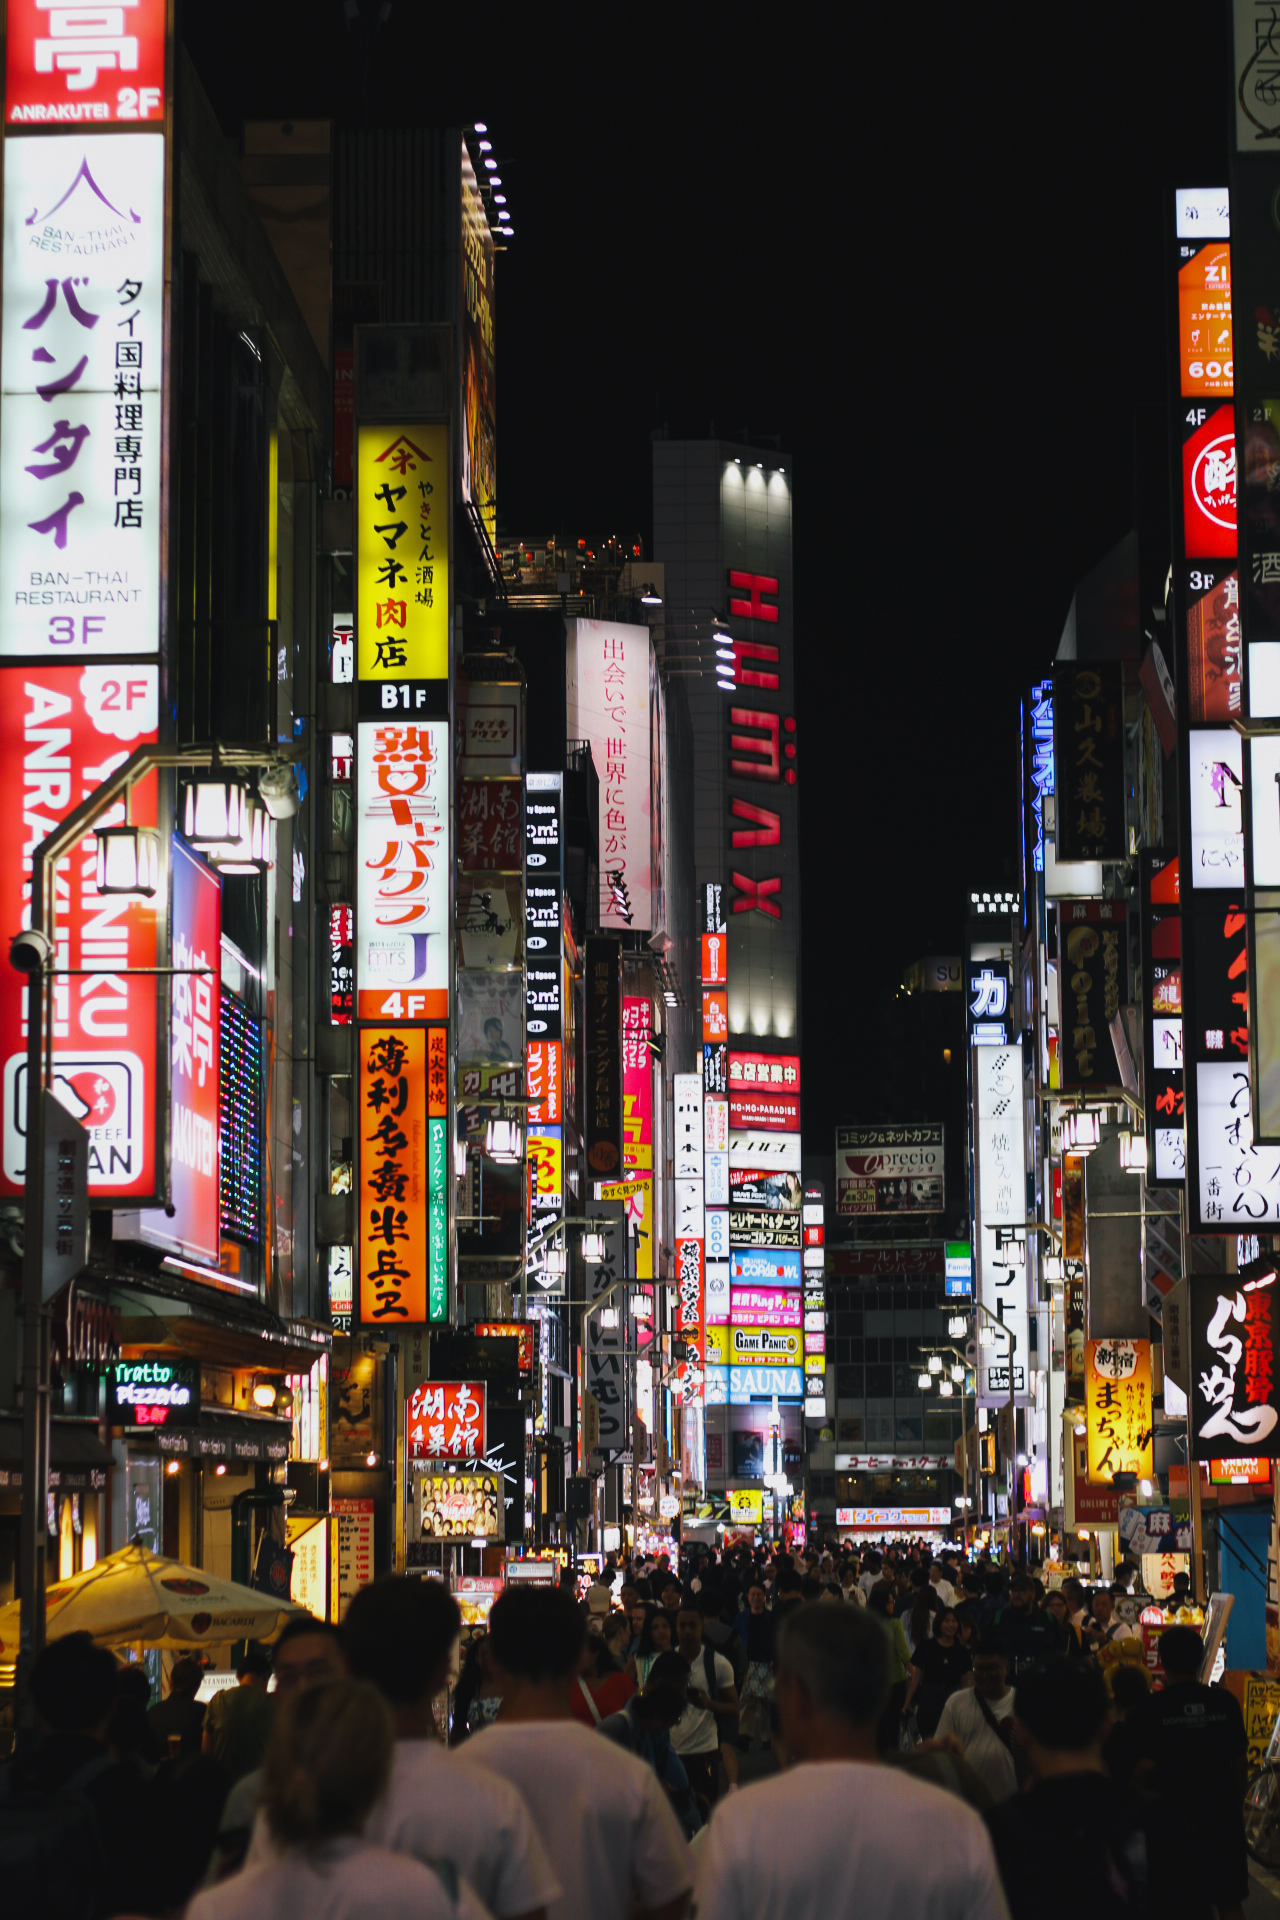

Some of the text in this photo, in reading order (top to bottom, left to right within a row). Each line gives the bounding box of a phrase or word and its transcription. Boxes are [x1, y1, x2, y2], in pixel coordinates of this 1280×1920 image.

[11, 88, 161, 121] ANRAKUTEI 2F
[22, 277, 100, 550] バンタイ
[114, 278, 144, 529] タイ国料理専門店
[1186, 408, 1206, 426] 4F
[414, 480, 435, 609] やきとん酒場
[30, 570, 128, 587] BAN-THAI
[371, 482, 409, 671] ヤマネ肉店
[1189, 570, 1214, 590] 3F
[15, 588, 143, 606] RESTAURANT
[48, 616, 106, 645] 3F
[100, 680, 149, 712] 2F
[381, 684, 427, 709] B1F
[971, 892, 1019, 903] 歌舞伎町
[1072, 904, 1114, 919] 麻雀
[1154, 967, 1168, 978] 3F
[380, 991, 426, 1019] 4F
[428, 1036, 446, 1105] 炭火串焼
[729, 1060, 797, 1085] 全店営業中
[87, 1129, 124, 1140] EEF
[840, 1129, 941, 1145] コミック&ネットカフェ
[602, 1182, 650, 1199] 今すぐ見つかる
[1205, 1166, 1224, 1221] 一番街
[730, 1212, 799, 1231] ビリヤード&ダーツ
[850, 1250, 945, 1263] ゴールドラッ
[1097, 1347, 1134, 1369] 新宿
[1244, 1291, 1275, 1404] 東京豚骨
[730, 1368, 803, 1394] SAUNA
[116, 1383, 191, 1406] Pizzeria
[412, 1386, 480, 1422] 湖南
[135, 1404, 169, 1425] Bar
[1096, 1382, 1123, 1472] まっちゃん
[427, 1424, 480, 1458] 菜館
[1221, 1466, 1258, 1476] ITALIAN
[1175, 1513, 1191, 1524] フリ
